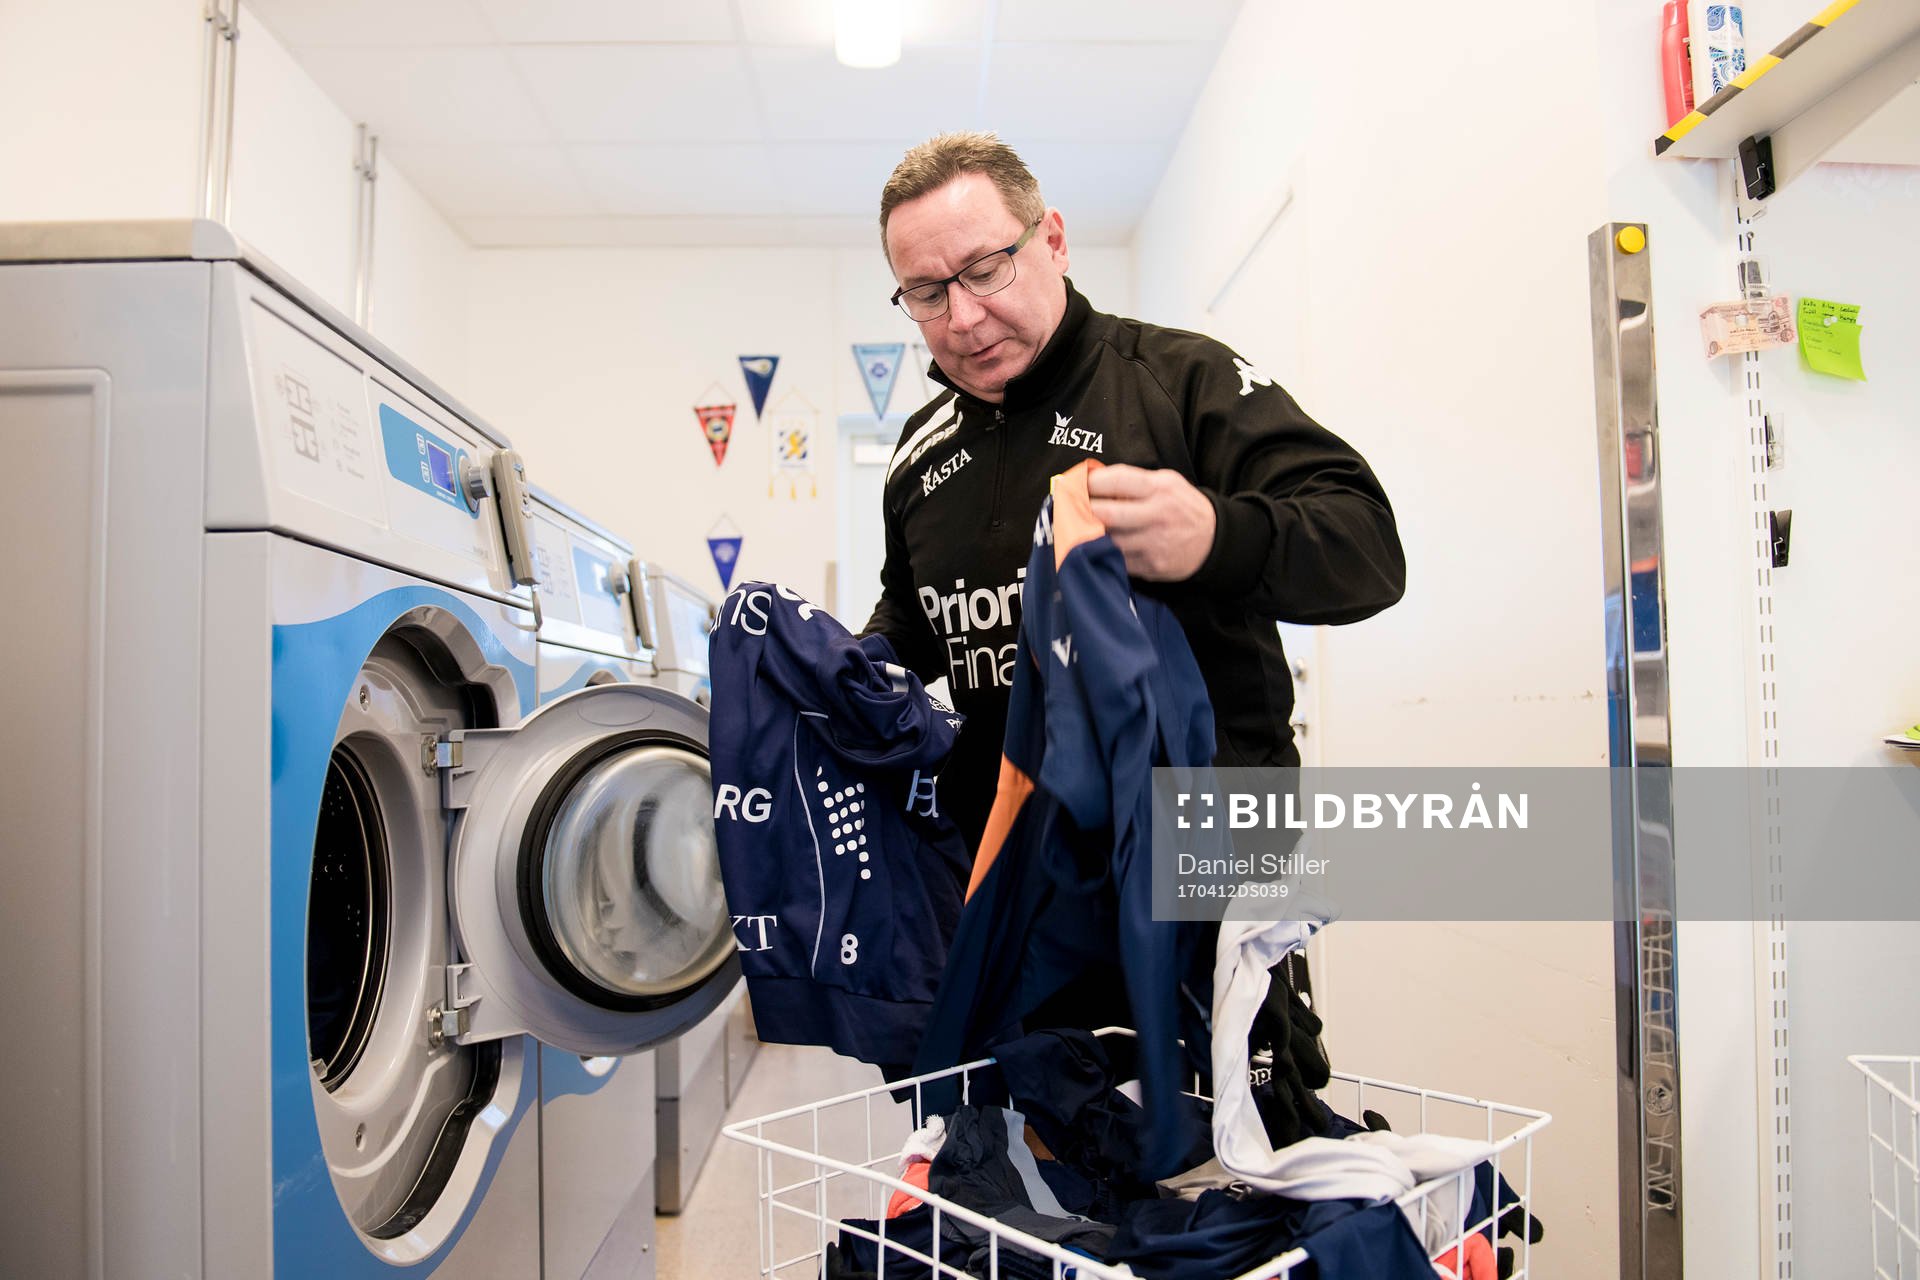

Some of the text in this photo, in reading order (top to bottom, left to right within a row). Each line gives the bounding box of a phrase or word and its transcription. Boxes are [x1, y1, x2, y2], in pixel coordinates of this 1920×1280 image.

[1048, 425, 1103, 454] RASTA
[946, 635, 1019, 690] Fina
[713, 783, 773, 823] RG
[840, 933, 859, 965] 8
